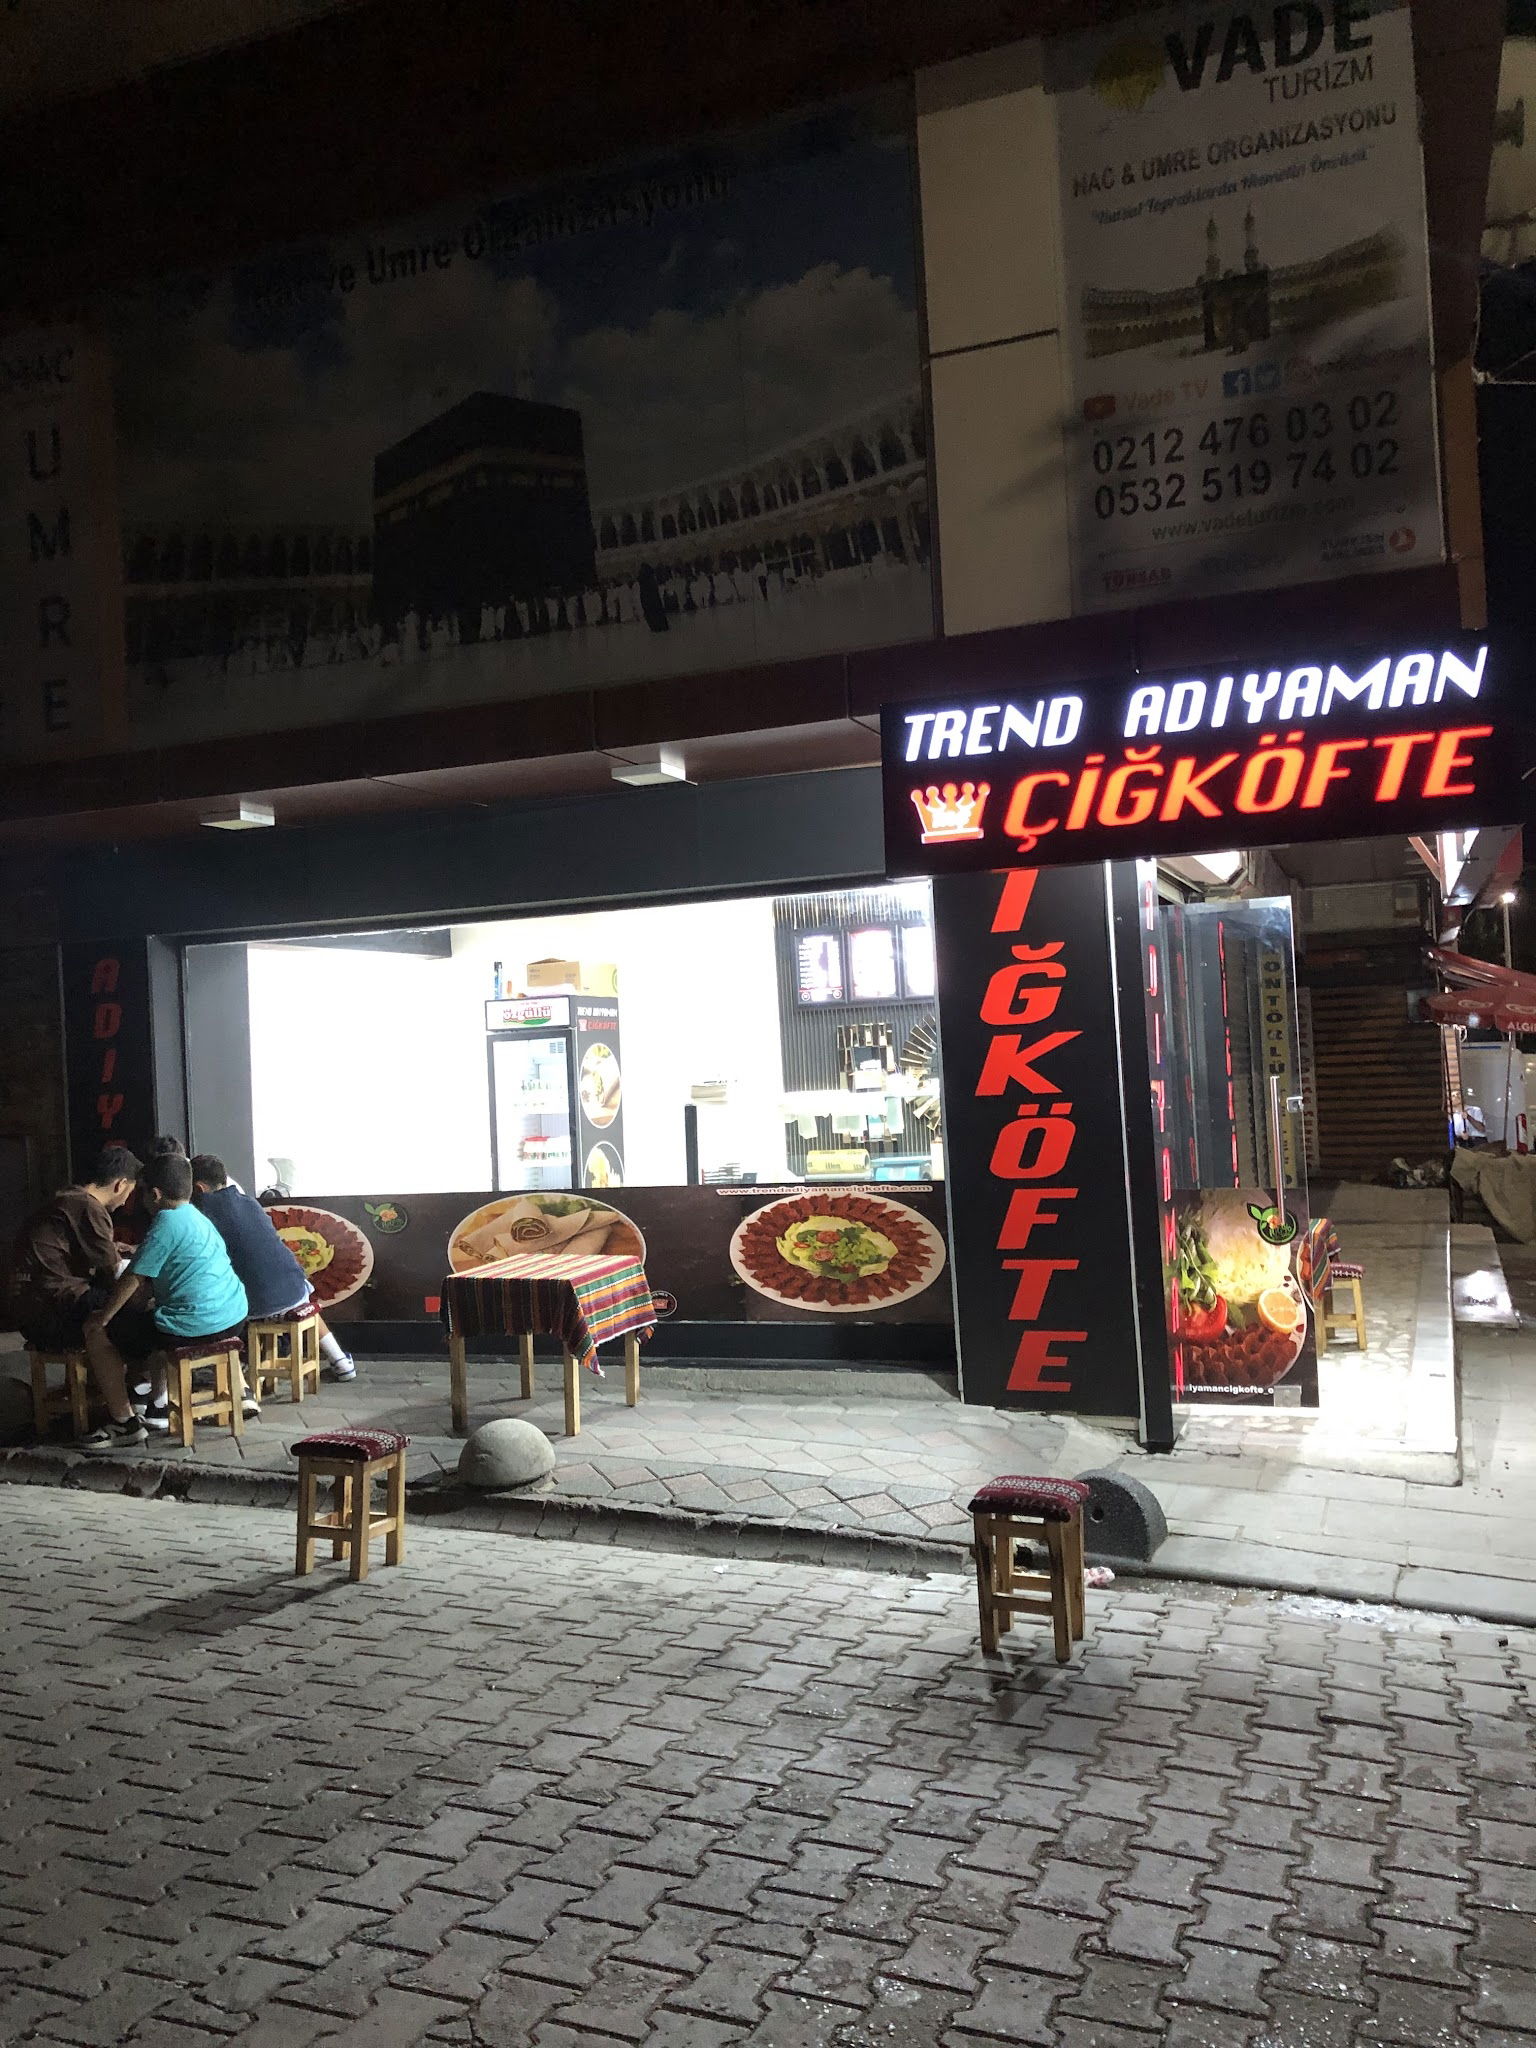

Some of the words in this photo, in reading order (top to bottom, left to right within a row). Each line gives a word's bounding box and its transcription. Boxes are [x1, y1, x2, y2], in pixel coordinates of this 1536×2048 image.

[1164, 0, 1373, 91] VADE
[1121, 161, 1136, 186] &
[1141, 146, 1201, 181] UMRE
[368, 237, 452, 286] Umre
[1181, 380, 1209, 401] TV
[1092, 428, 1184, 474] 0212
[1199, 413, 1270, 456] 476
[1286, 401, 1332, 442] 03
[1347, 391, 1398, 430] 02
[1094, 473, 1186, 519] 0532
[1202, 459, 1271, 503] 519
[1287, 449, 1336, 489] 74
[1350, 439, 1400, 479] 02
[25, 425, 72, 731] UMRE
[903, 695, 1085, 764] TREND
[1123, 645, 1490, 739] ADIYAMAN
[1002, 725, 1495, 853] ÇİĞKÖFTE
[91, 957, 126, 1149] ADIY
[718, 1184, 932, 1195] www.trendadiyamancigkofte.com
